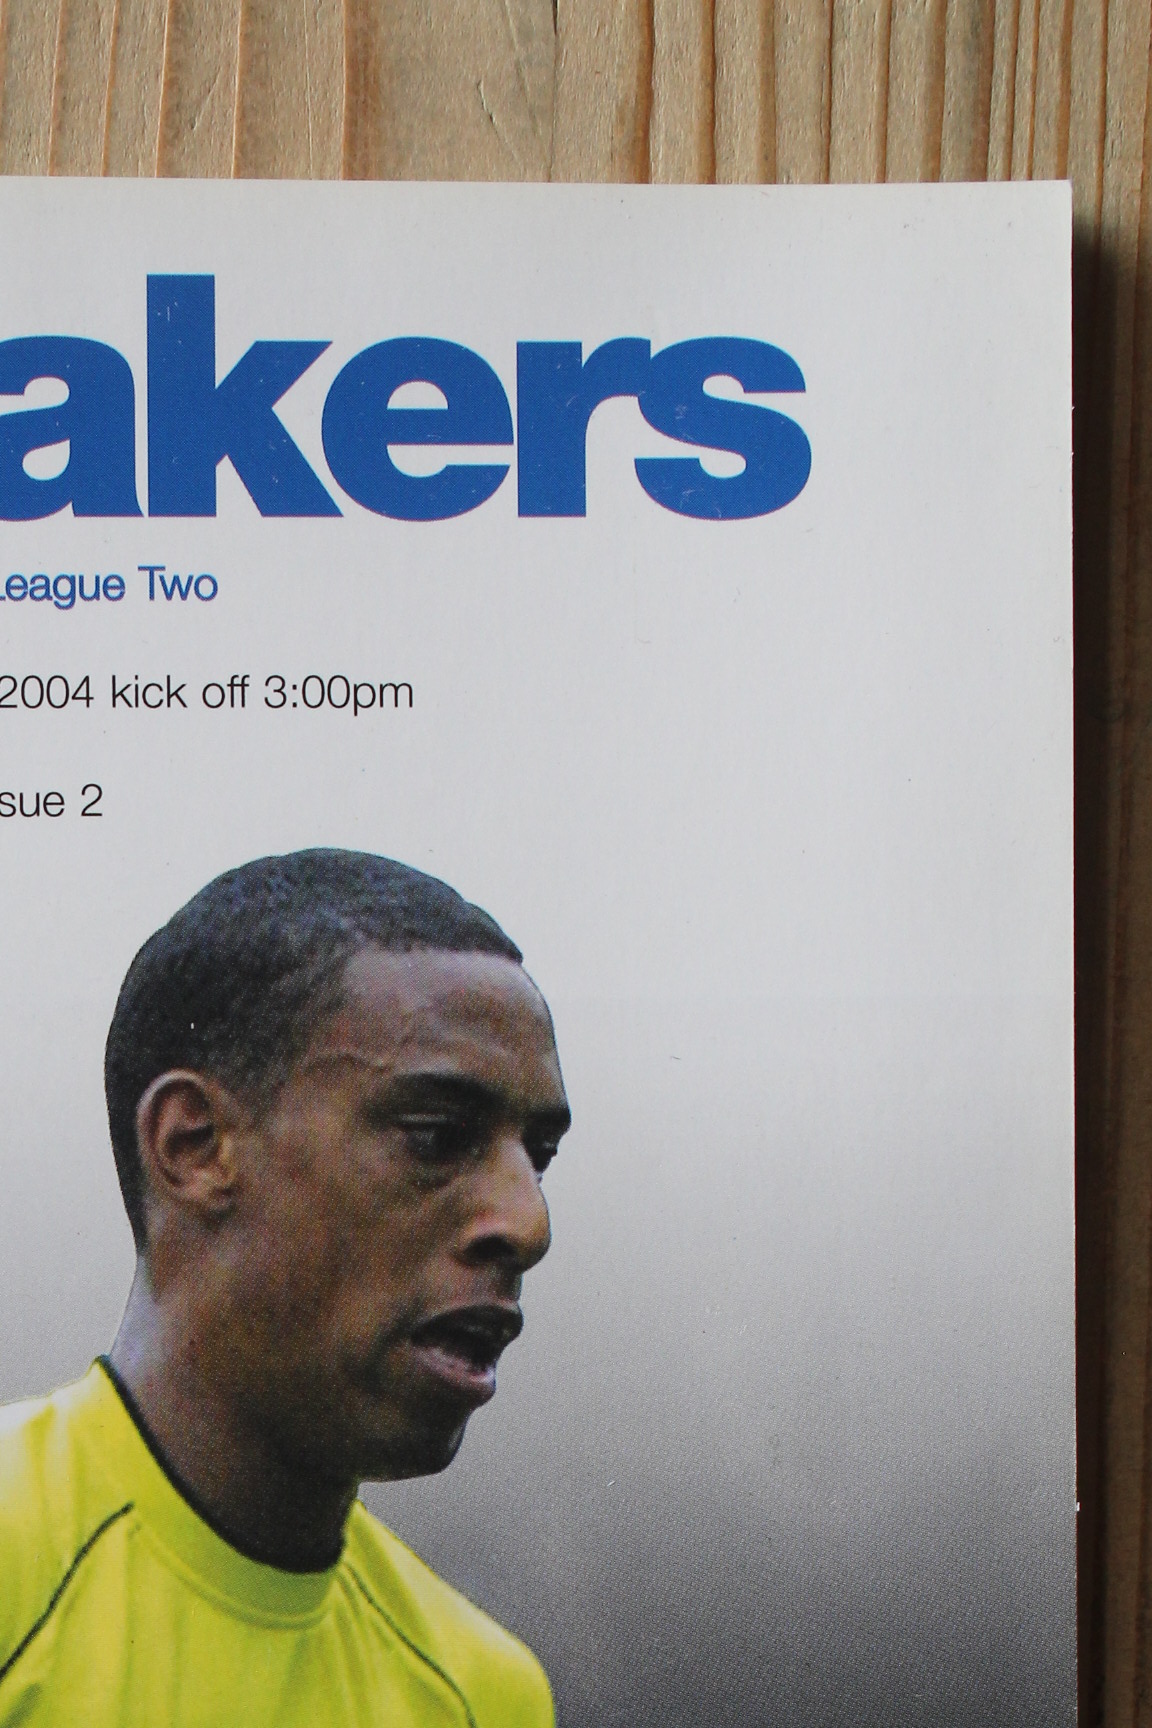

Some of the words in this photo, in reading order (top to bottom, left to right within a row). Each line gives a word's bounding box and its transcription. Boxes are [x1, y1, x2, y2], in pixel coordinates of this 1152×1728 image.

[138, 566, 218, 602] Two
[112, 675, 187, 709] kick
[202, 675, 250, 709] off
[265, 675, 413, 717] 3:00pm
[81, 784, 103, 817] 2
